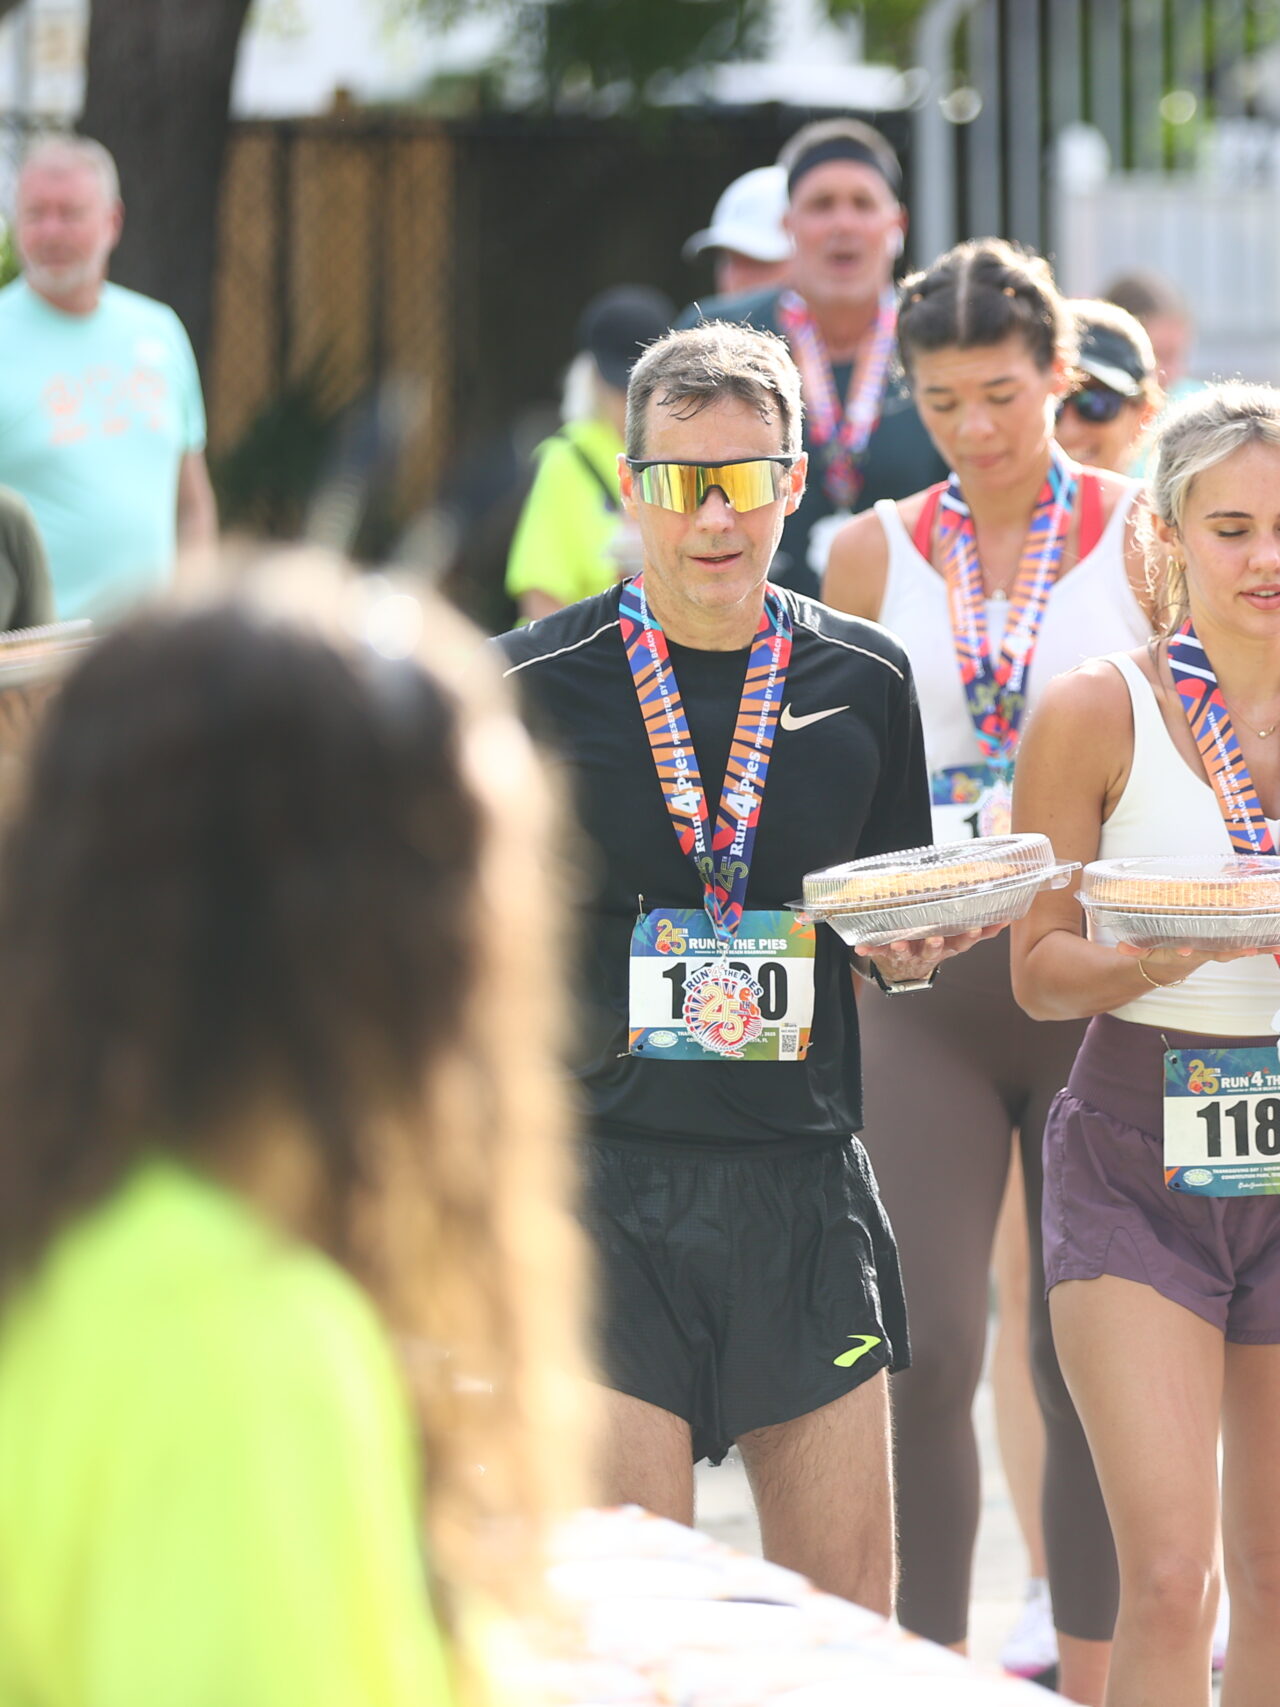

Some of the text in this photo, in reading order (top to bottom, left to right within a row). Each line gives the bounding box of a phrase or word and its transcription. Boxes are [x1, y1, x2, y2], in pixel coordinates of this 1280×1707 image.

[647, 631, 659, 659] BEACH
[771, 636, 782, 664] BEACH
[652, 660, 665, 683] PALM
[767, 664, 777, 688] PALM
[659, 684, 668, 696] BY
[765, 687, 774, 700] BY
[663, 696, 681, 745] PRESENTED
[754, 700, 771, 749] PRESENTED
[672, 748, 693, 792] Pies
[740, 751, 761, 793] Pies
[1207, 711, 1232, 772] THANKSGIVING
[1228, 771, 1238, 788] DAY
[1237, 795, 1258, 842] NOVEMBER
[670, 790, 702, 815] 4
[726, 791, 758, 818] 4
[1216, 771, 1240, 824] TEQUESTA, FL
[691, 813, 706, 853] Run
[729, 818, 749, 857] Run
[688, 938, 716, 950] RUN
[758, 938, 788, 950] PIES
[686, 968, 710, 990] RUN
[724, 970, 738, 978] THE
[740, 972, 763, 996] PIES
[1221, 1076, 1249, 1088] RUN
[1251, 1071, 1264, 1086] 4
